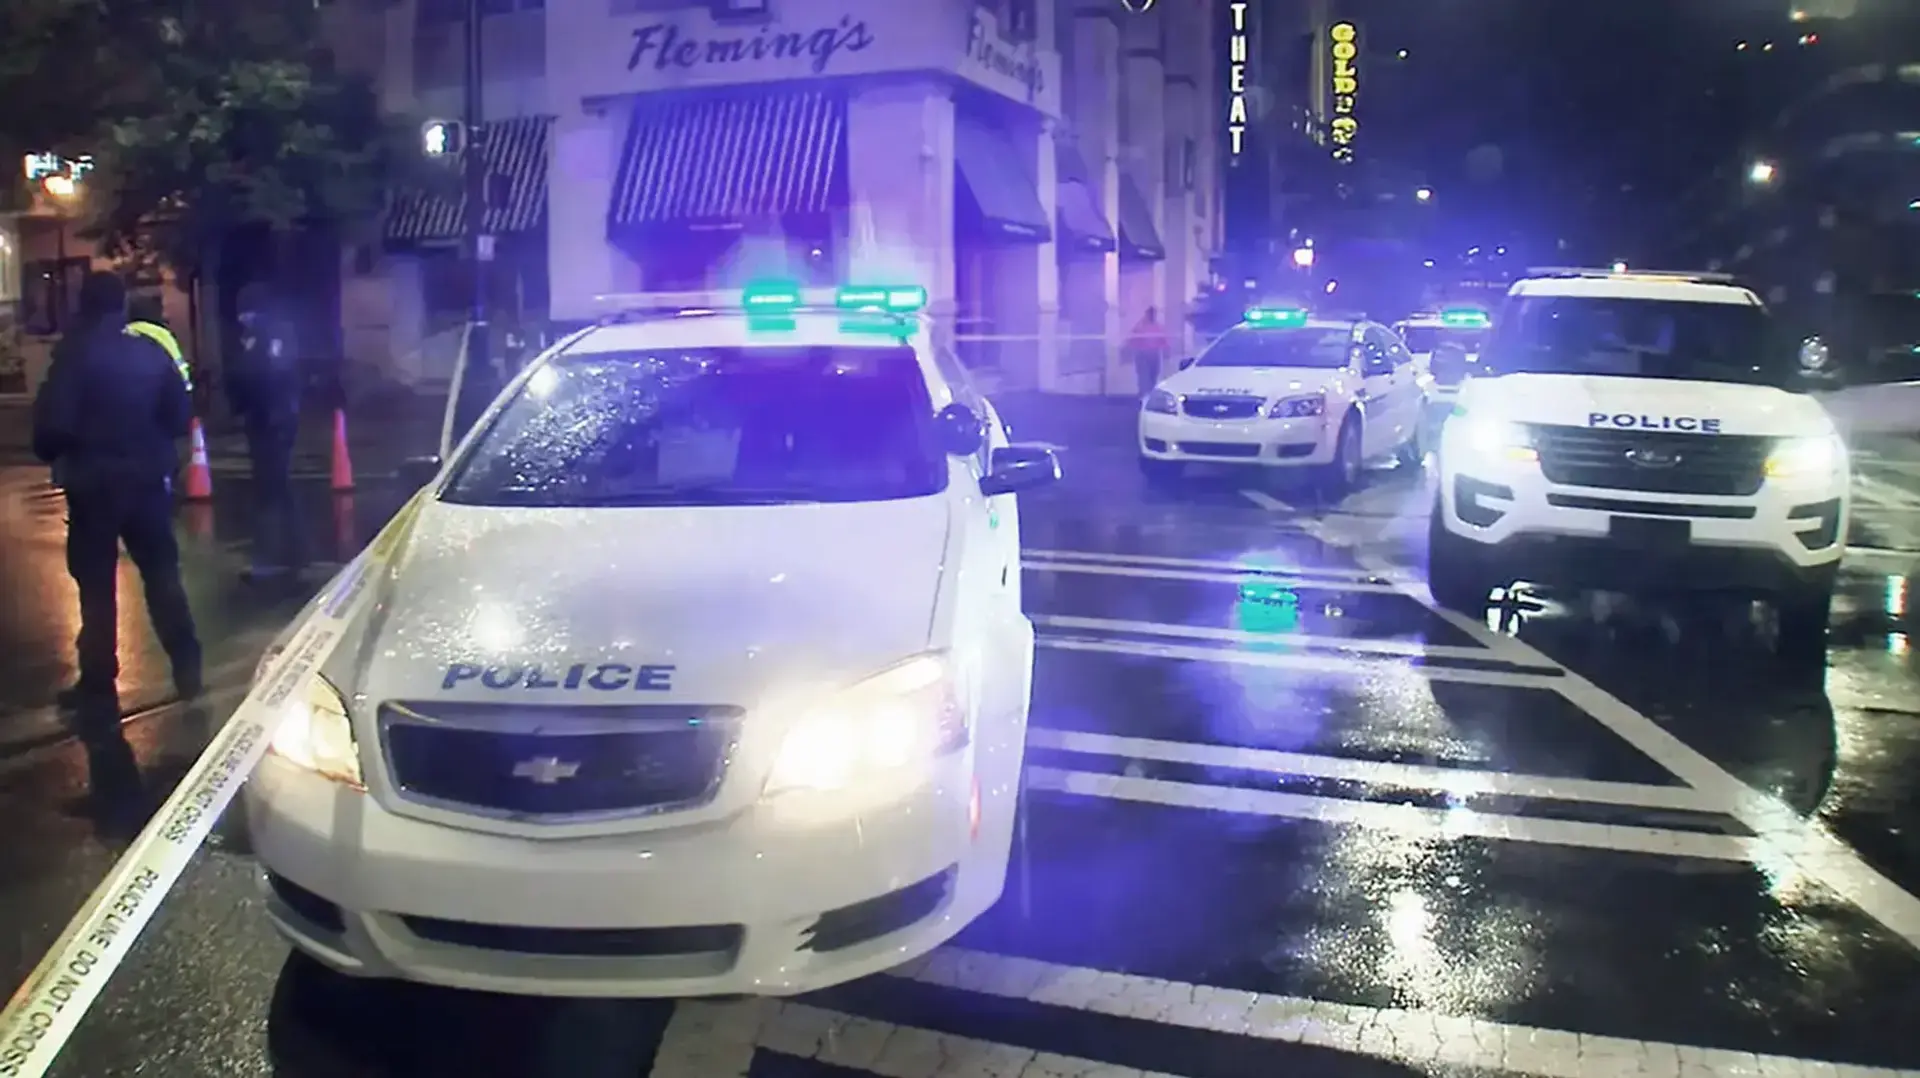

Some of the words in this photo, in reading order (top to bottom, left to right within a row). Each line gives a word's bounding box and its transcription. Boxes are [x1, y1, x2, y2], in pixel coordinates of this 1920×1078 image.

[627, 14, 875, 73] Fleming's
[1588, 412, 1722, 434] POLICE
[441, 663, 677, 692] POLICE
[113, 867, 158, 917] POLICE
[89, 913, 125, 949] LINE
[69, 949, 98, 977] DO
[43, 974, 79, 1013] NOT
[0, 1011, 53, 1077] CROSS
